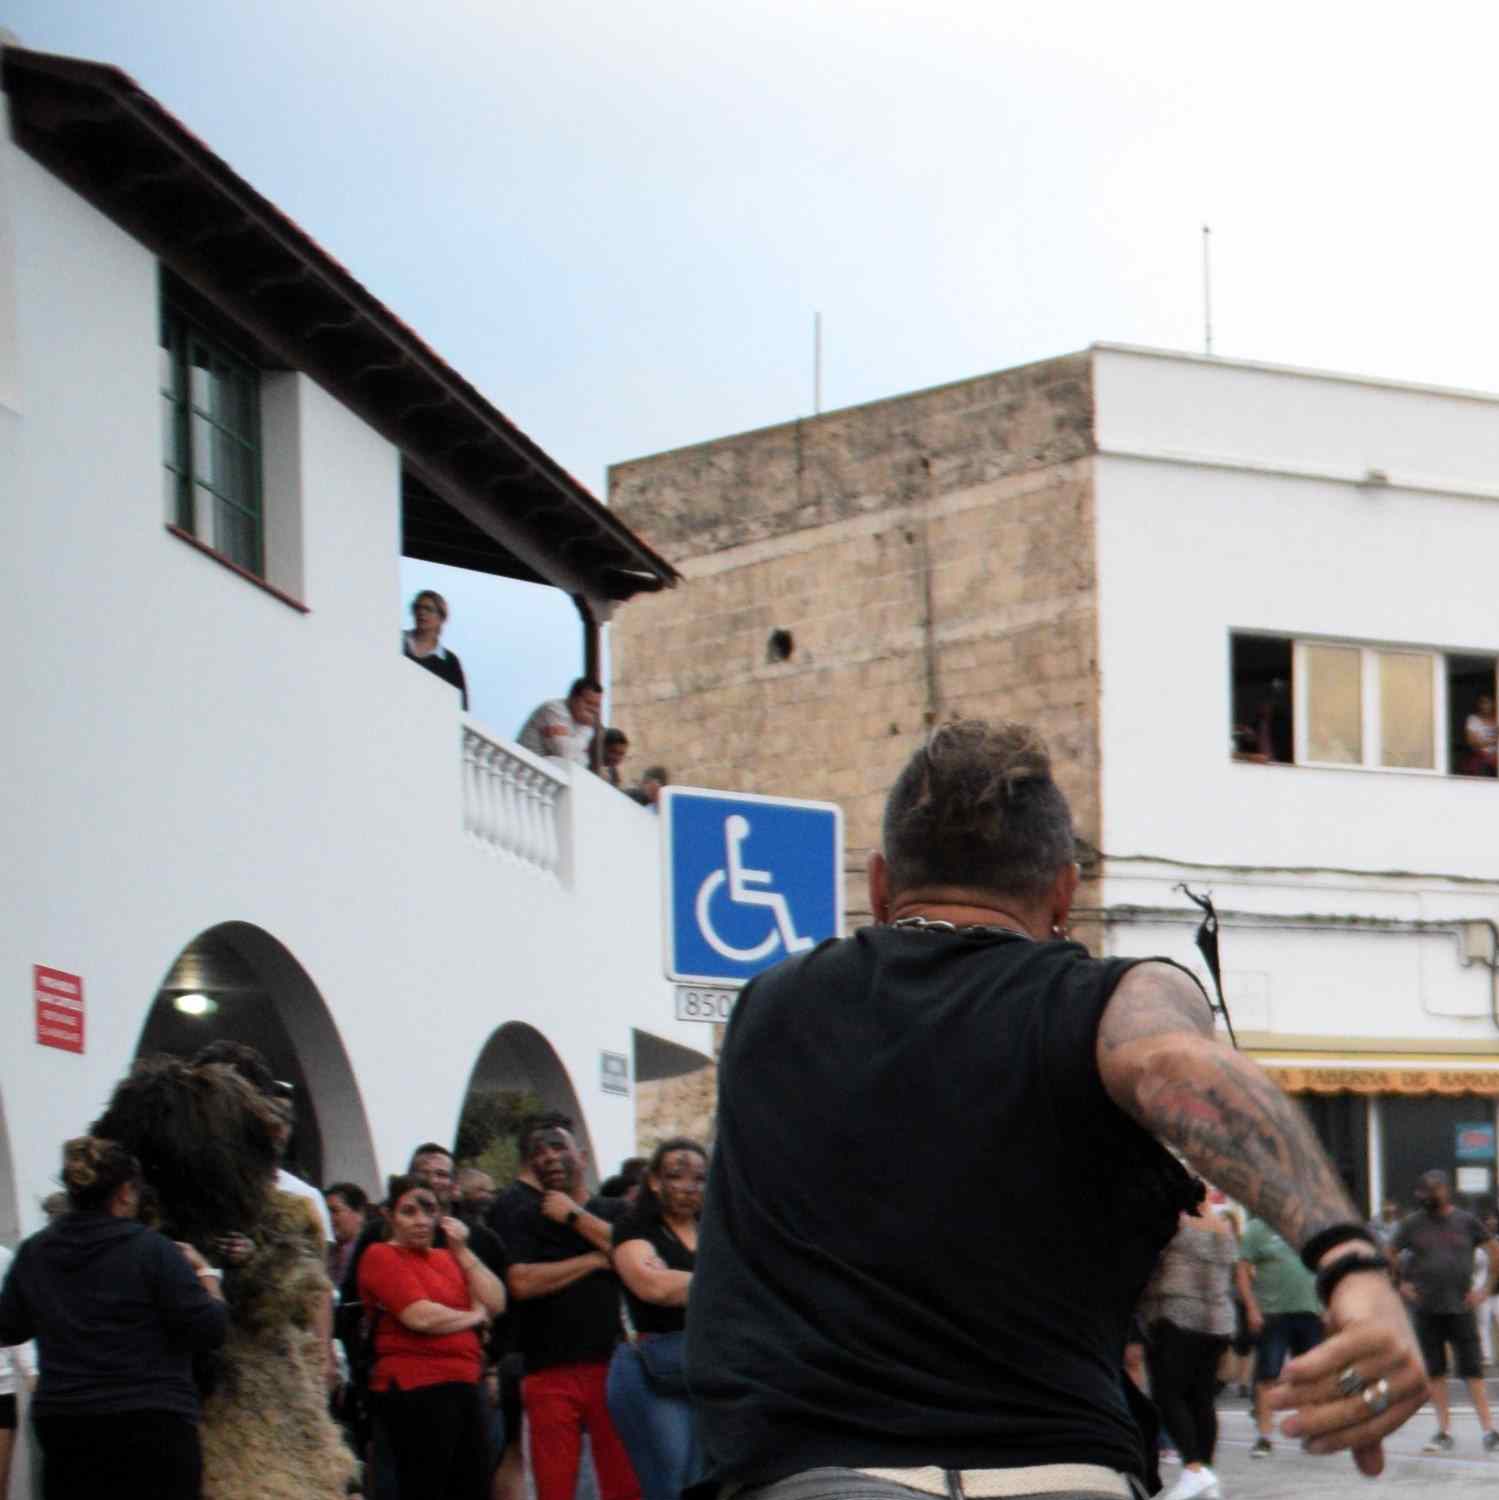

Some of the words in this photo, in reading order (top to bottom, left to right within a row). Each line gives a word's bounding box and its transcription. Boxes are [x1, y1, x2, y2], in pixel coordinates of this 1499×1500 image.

[686, 991, 732, 1018] 850
[1302, 1069, 1389, 1087] TABERNA
[1401, 1070, 1427, 1087] DE
